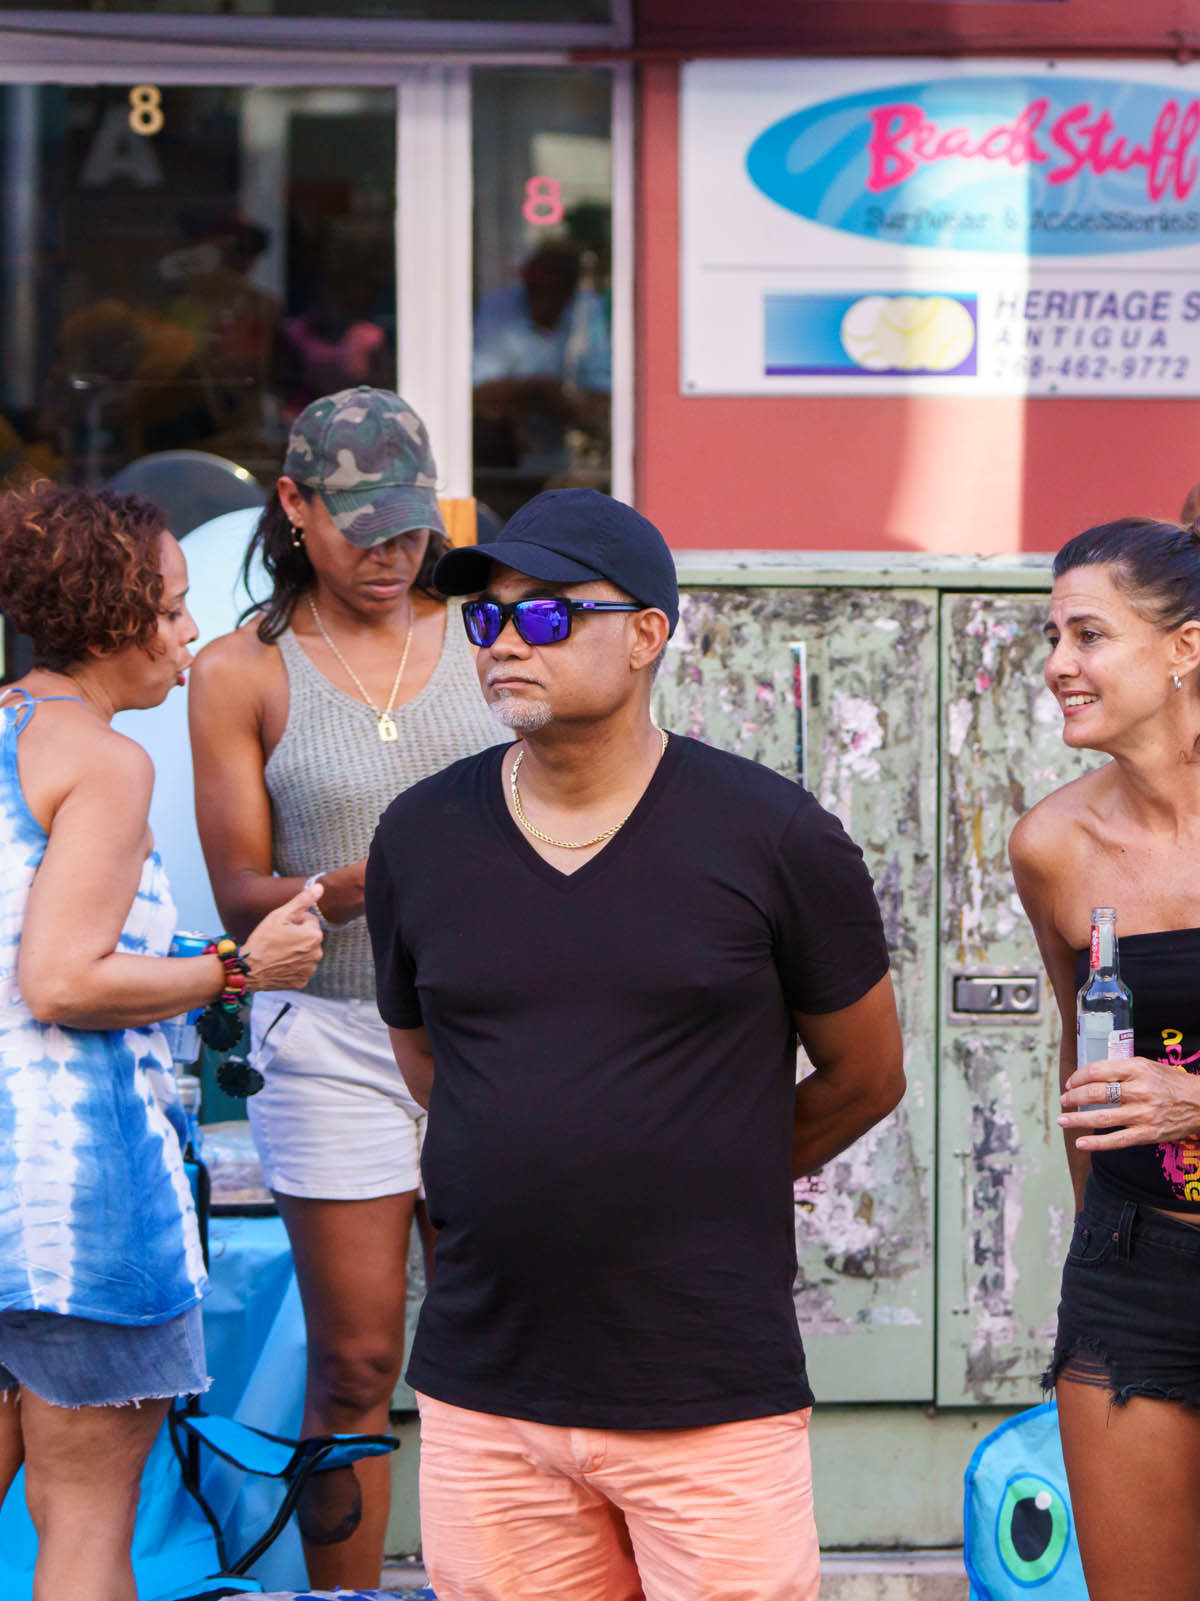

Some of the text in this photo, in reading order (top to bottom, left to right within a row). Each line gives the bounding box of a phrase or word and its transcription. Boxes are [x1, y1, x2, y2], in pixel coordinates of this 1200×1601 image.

[128, 84, 164, 136] 8
[866, 97, 1049, 192] Beach
[522, 175, 565, 226] 8
[996, 290, 1173, 322] HERITAGE
[997, 326, 1167, 350] ANTIGUA
